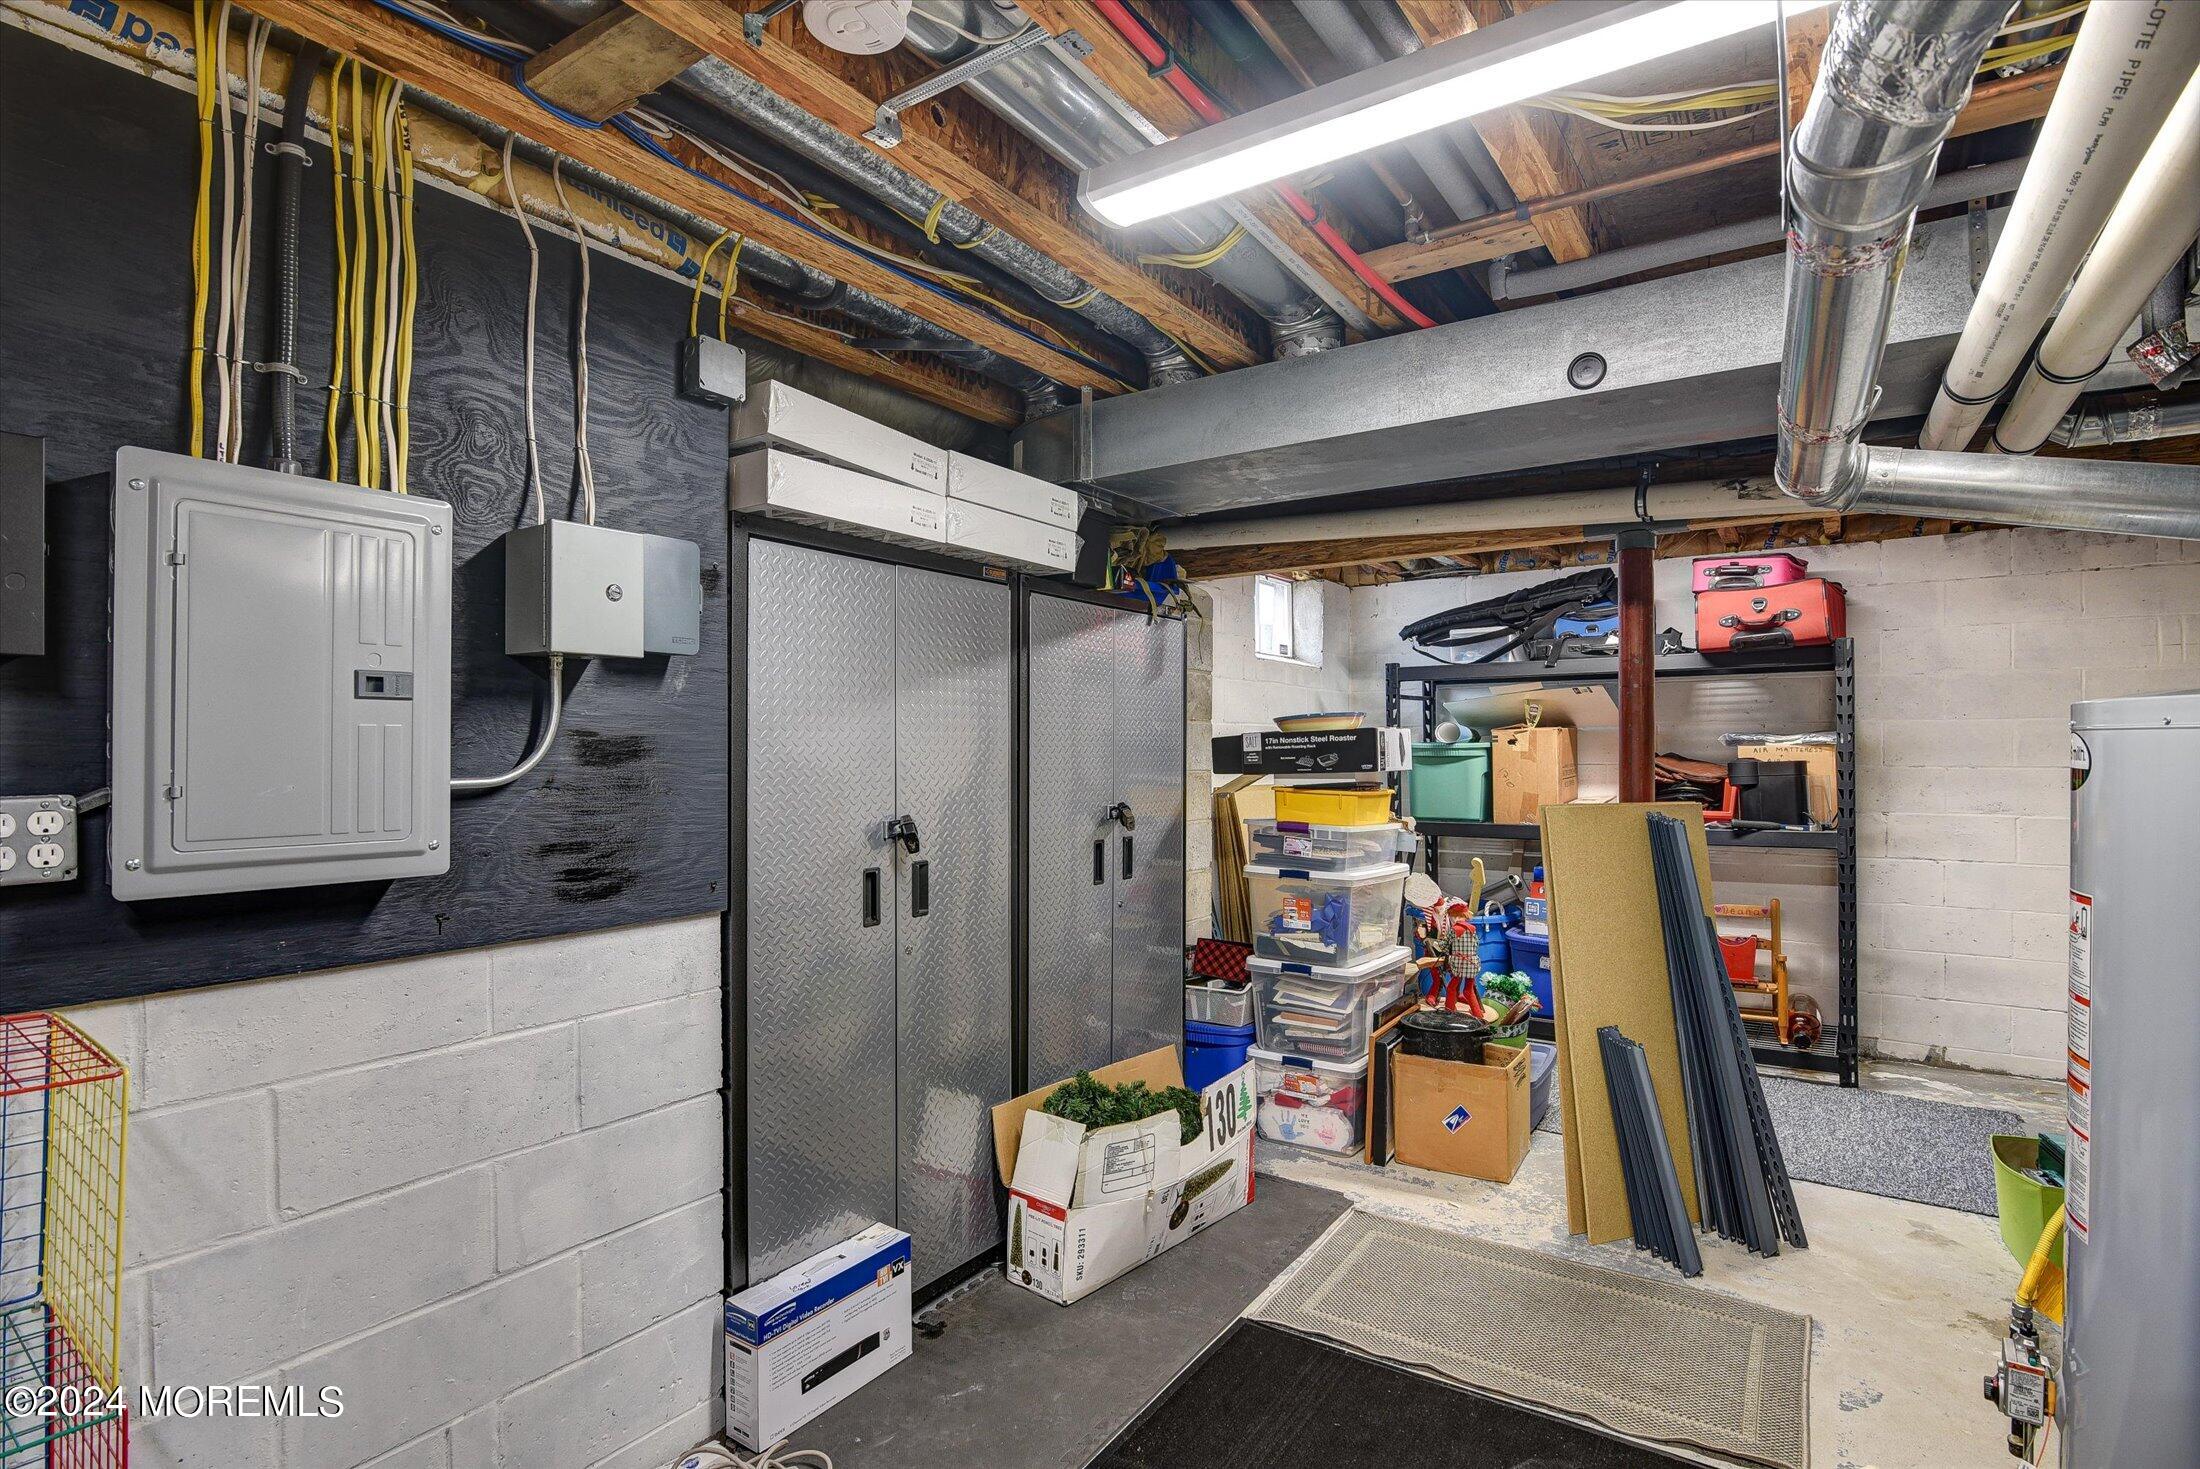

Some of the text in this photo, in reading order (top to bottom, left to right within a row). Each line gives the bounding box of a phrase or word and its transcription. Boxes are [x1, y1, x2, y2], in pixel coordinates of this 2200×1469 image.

[1245, 735, 1258, 749] SALT
[1264, 734, 1357, 745] 17in Nonstick Steel Roaster
[1722, 905, 1760, 916] Deana
[1205, 1083, 1237, 1152] 130
[1075, 1228, 1086, 1282] SKU: 293311
[893, 1260, 904, 1274] VX
[1032, 1278, 1043, 1290] 130
[783, 1316, 799, 1331] Digital
[799, 1309, 814, 1321] Video
[814, 1297, 836, 1312] Recorder
